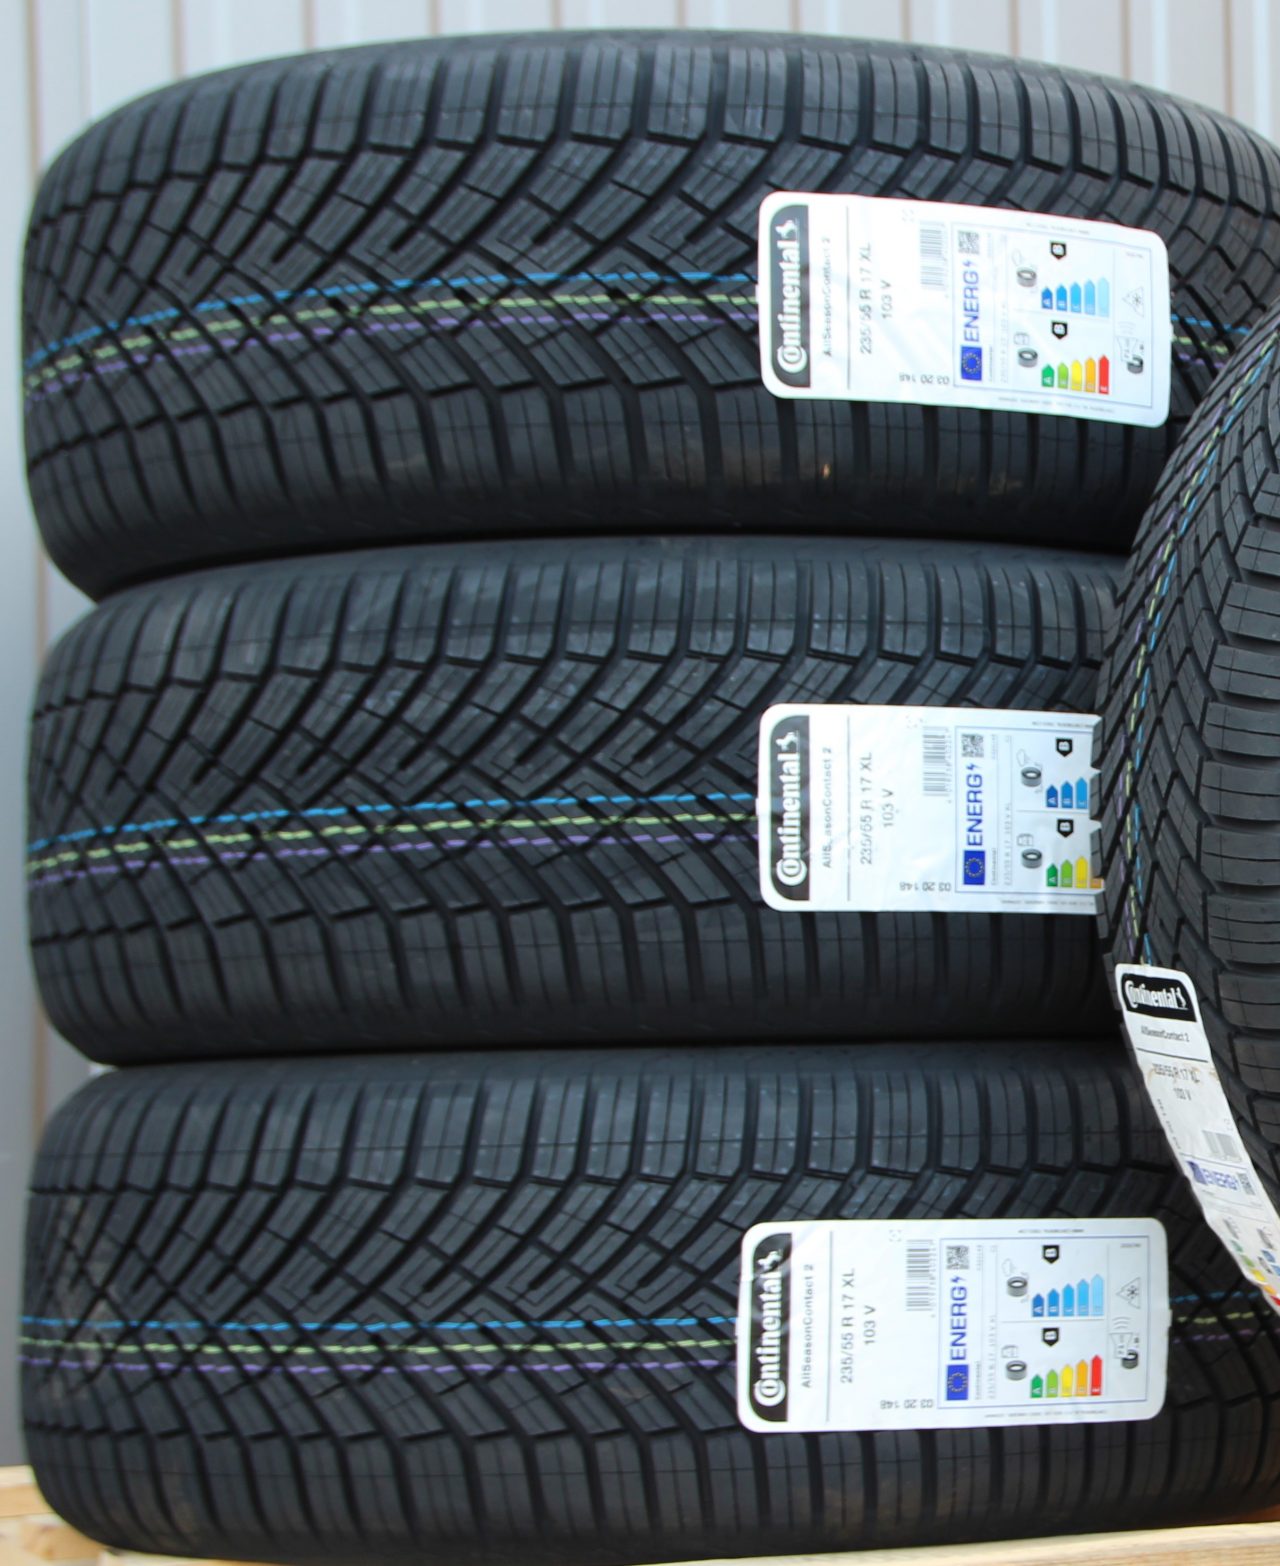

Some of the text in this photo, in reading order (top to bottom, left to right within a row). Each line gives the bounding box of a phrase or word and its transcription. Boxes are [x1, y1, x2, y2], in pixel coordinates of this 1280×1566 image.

[860, 243, 870, 261] XL
[777, 241, 807, 373] Continental
[860, 289, 871, 299] R
[882, 280, 892, 319] 103 V
[963, 271, 979, 342] ENERG
[859, 305, 872, 354] 235/55
[861, 753, 872, 771] XL
[861, 778, 872, 792] 17
[776, 752, 807, 885] Continental
[882, 788, 893, 828] 103 V
[967, 774, 982, 846] ENERG
[861, 815, 872, 864] 235/55
[922, 882, 934, 891] 20
[1124, 980, 1178, 1009] Continental
[754, 1271, 786, 1406] Continental
[802, 1277, 813, 1388] AllSeasonContact
[841, 1269, 854, 1383] 235/55 R 17 XL
[864, 1305, 876, 1345] 103 V
[950, 1287, 967, 1360] ENERG
[904, 1400, 917, 1408] 20
